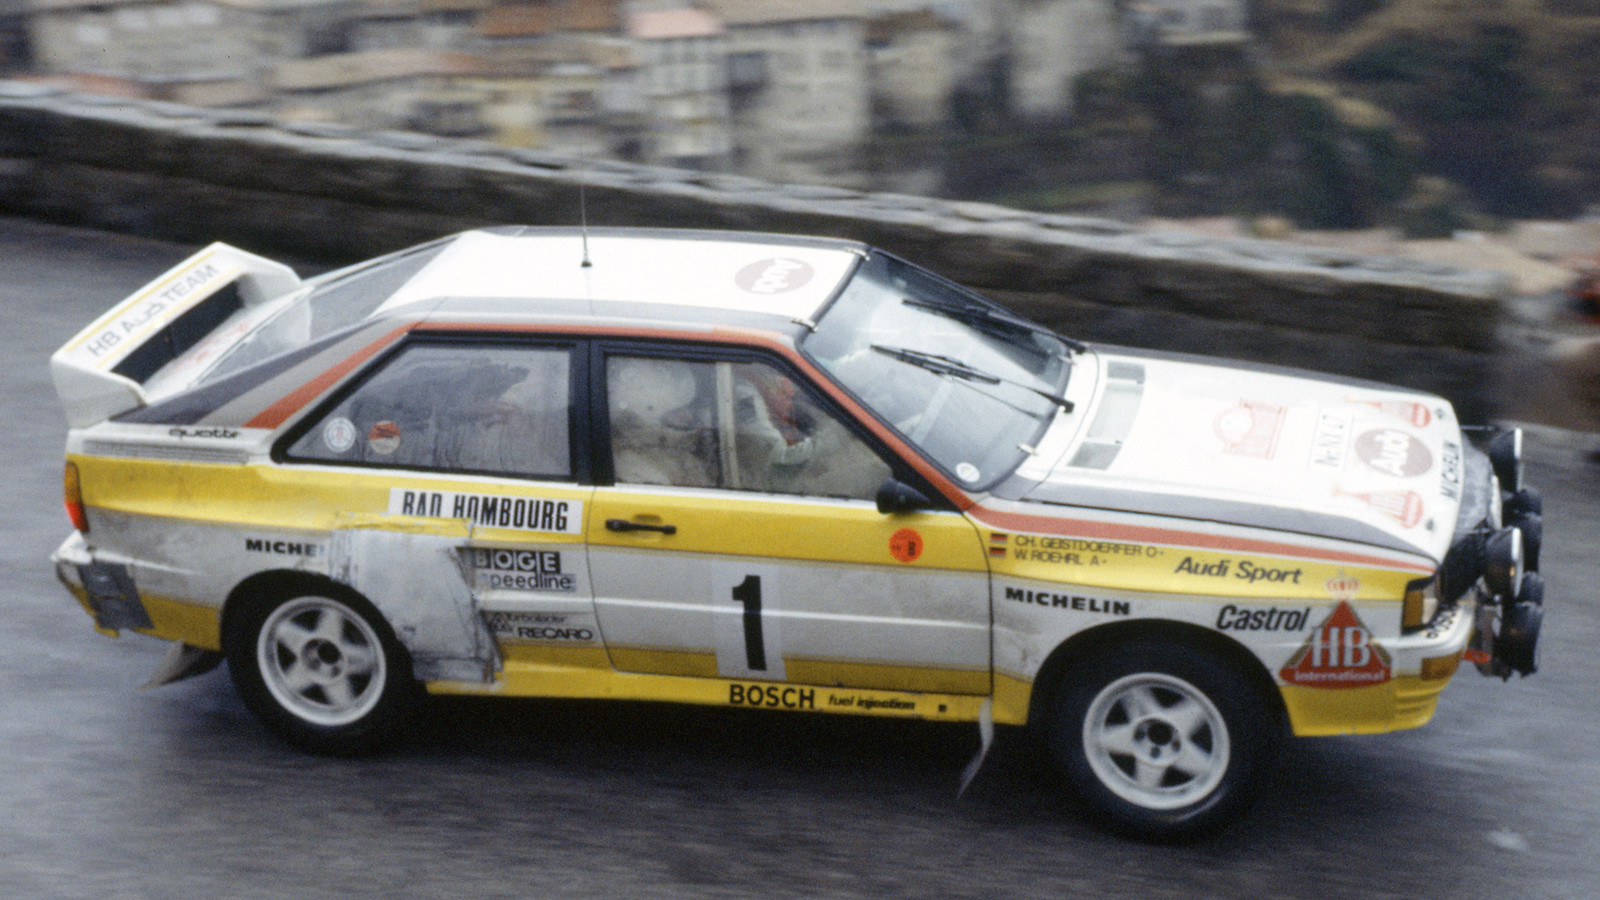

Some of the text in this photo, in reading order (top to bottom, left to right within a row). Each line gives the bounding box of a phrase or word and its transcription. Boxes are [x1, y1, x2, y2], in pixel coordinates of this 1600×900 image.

[87, 329, 120, 357] HB
[162, 264, 219, 303] TEAM
[453, 494, 569, 532] HOMBOURG
[1030, 549, 1083, 565] ROEHRL
[1040, 537, 1142, 556] GEISTDOERFER
[481, 573, 573, 591] peedline
[1175, 556, 1303, 585] Audi Sport
[1005, 586, 1131, 616] MICHELIN
[731, 574, 767, 672] 1
[1216, 604, 1312, 632] Castrol
[517, 626, 593, 641] RECARO
[1311, 626, 1371, 668] HB
[1293, 668, 1385, 683] international
[729, 683, 815, 710] BOSCH
[828, 694, 916, 711] fuel injection
